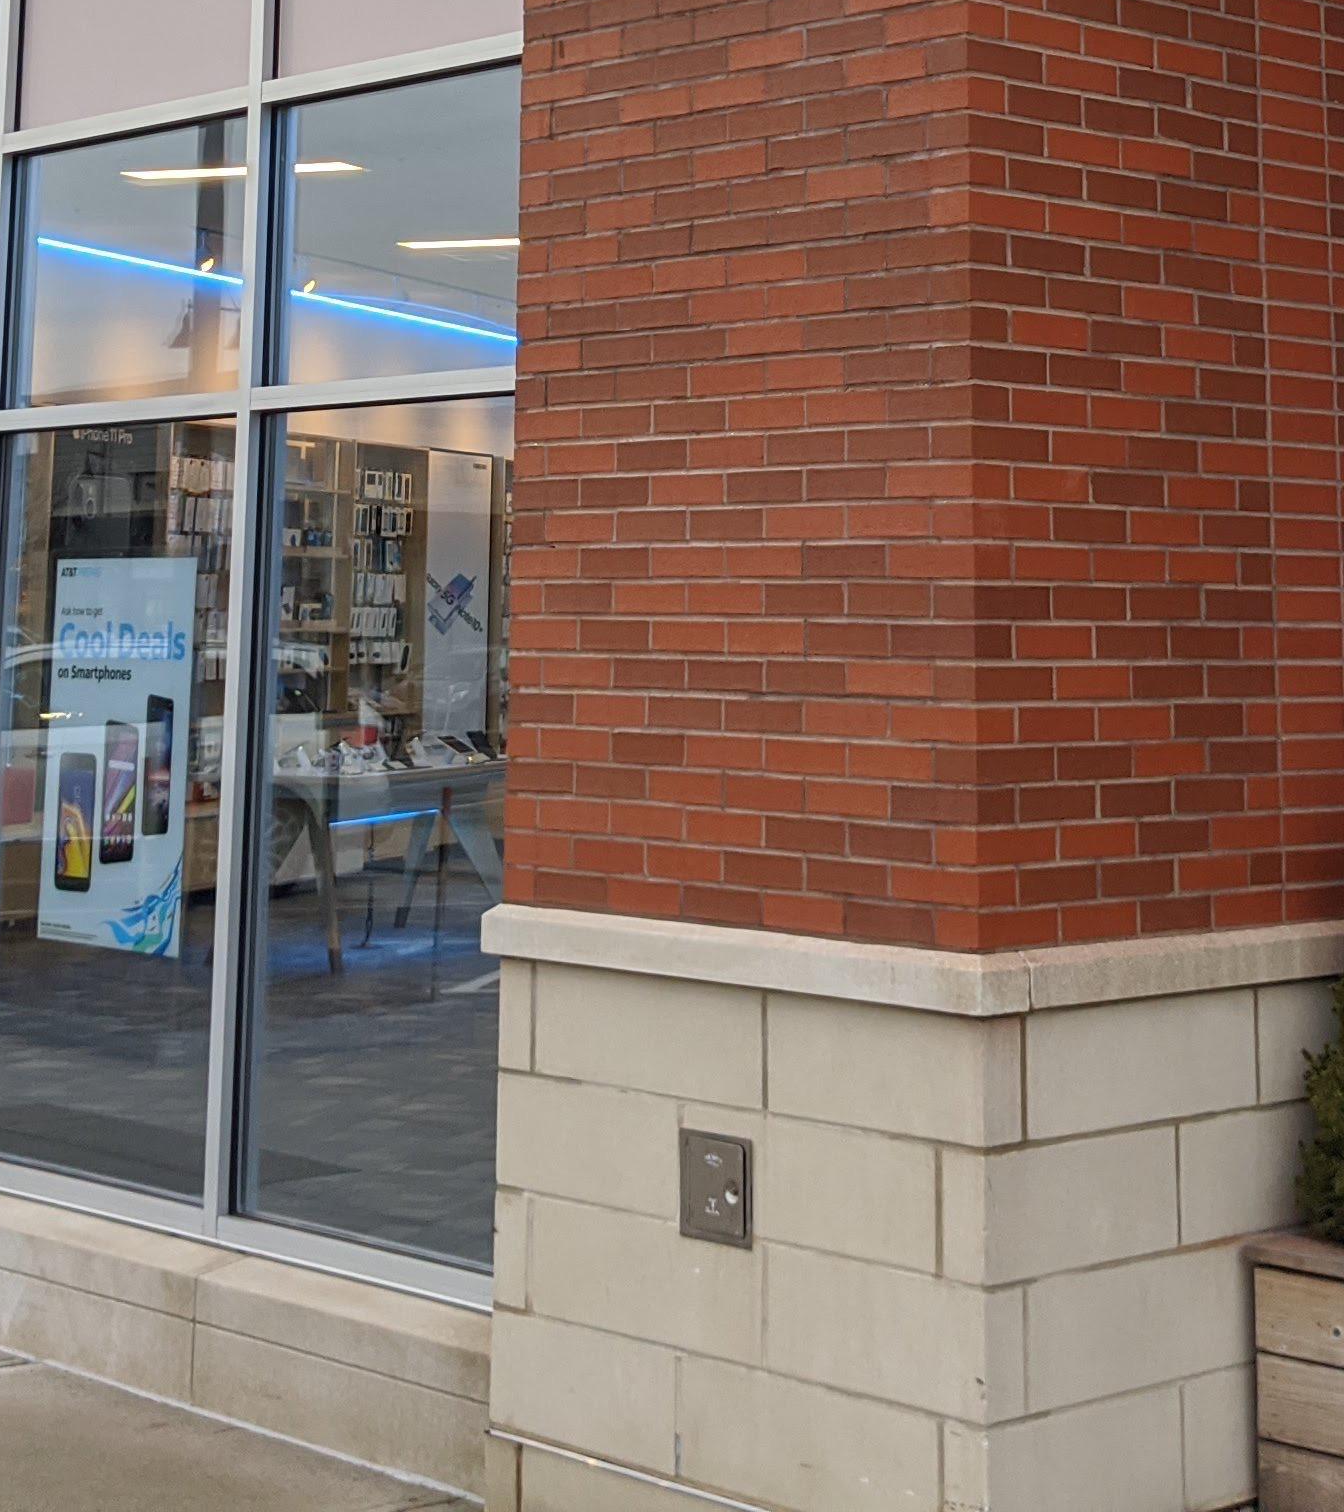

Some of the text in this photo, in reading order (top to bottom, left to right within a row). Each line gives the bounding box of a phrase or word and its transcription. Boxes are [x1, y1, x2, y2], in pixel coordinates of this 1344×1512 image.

[60, 620, 186, 661] Cool Deals
[58, 665, 132, 683] on Smartphones
